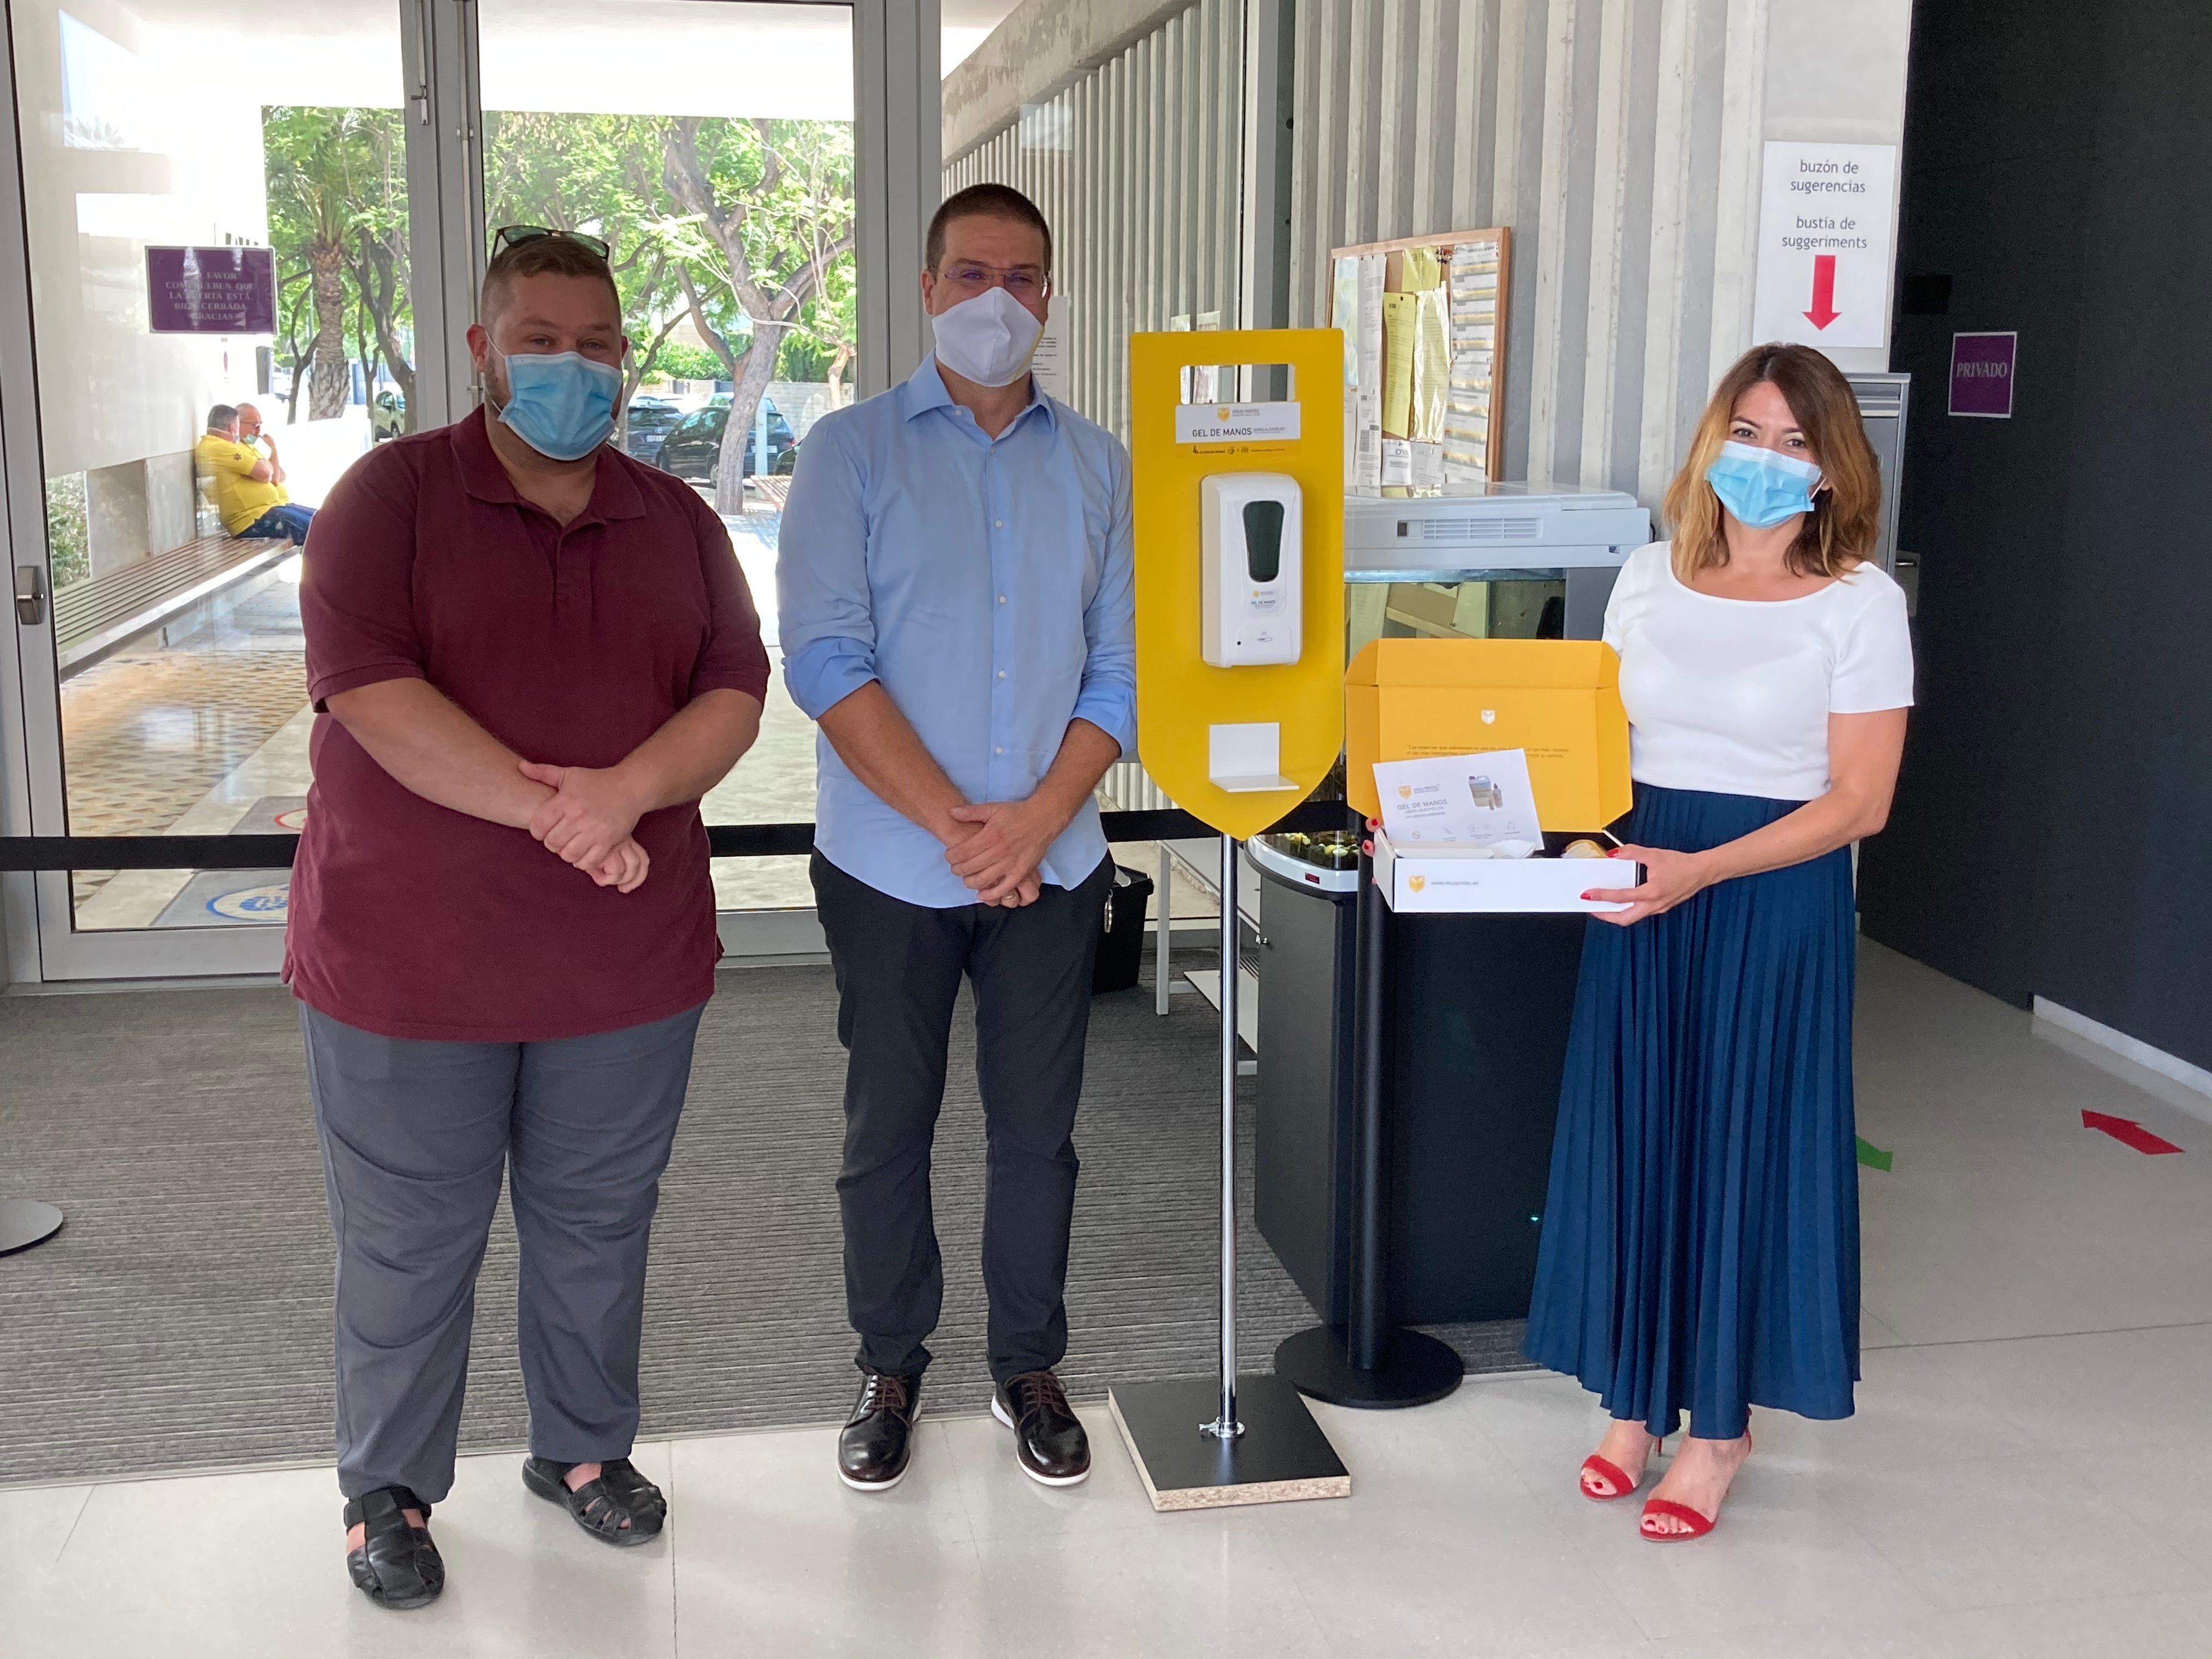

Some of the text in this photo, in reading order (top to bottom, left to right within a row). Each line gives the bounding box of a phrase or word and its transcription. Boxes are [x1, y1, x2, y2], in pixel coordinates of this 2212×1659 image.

[1800, 159, 1859, 174] buzón de
[1791, 180, 1866, 194] sugerencias
[1796, 216, 1856, 230] bustia de
[1782, 235, 1867, 250] suggeriments
[1956, 362, 2008, 378] PRIVADO
[1223, 427, 1252, 436] MANOS
[1423, 799, 1448, 807] MANOS
